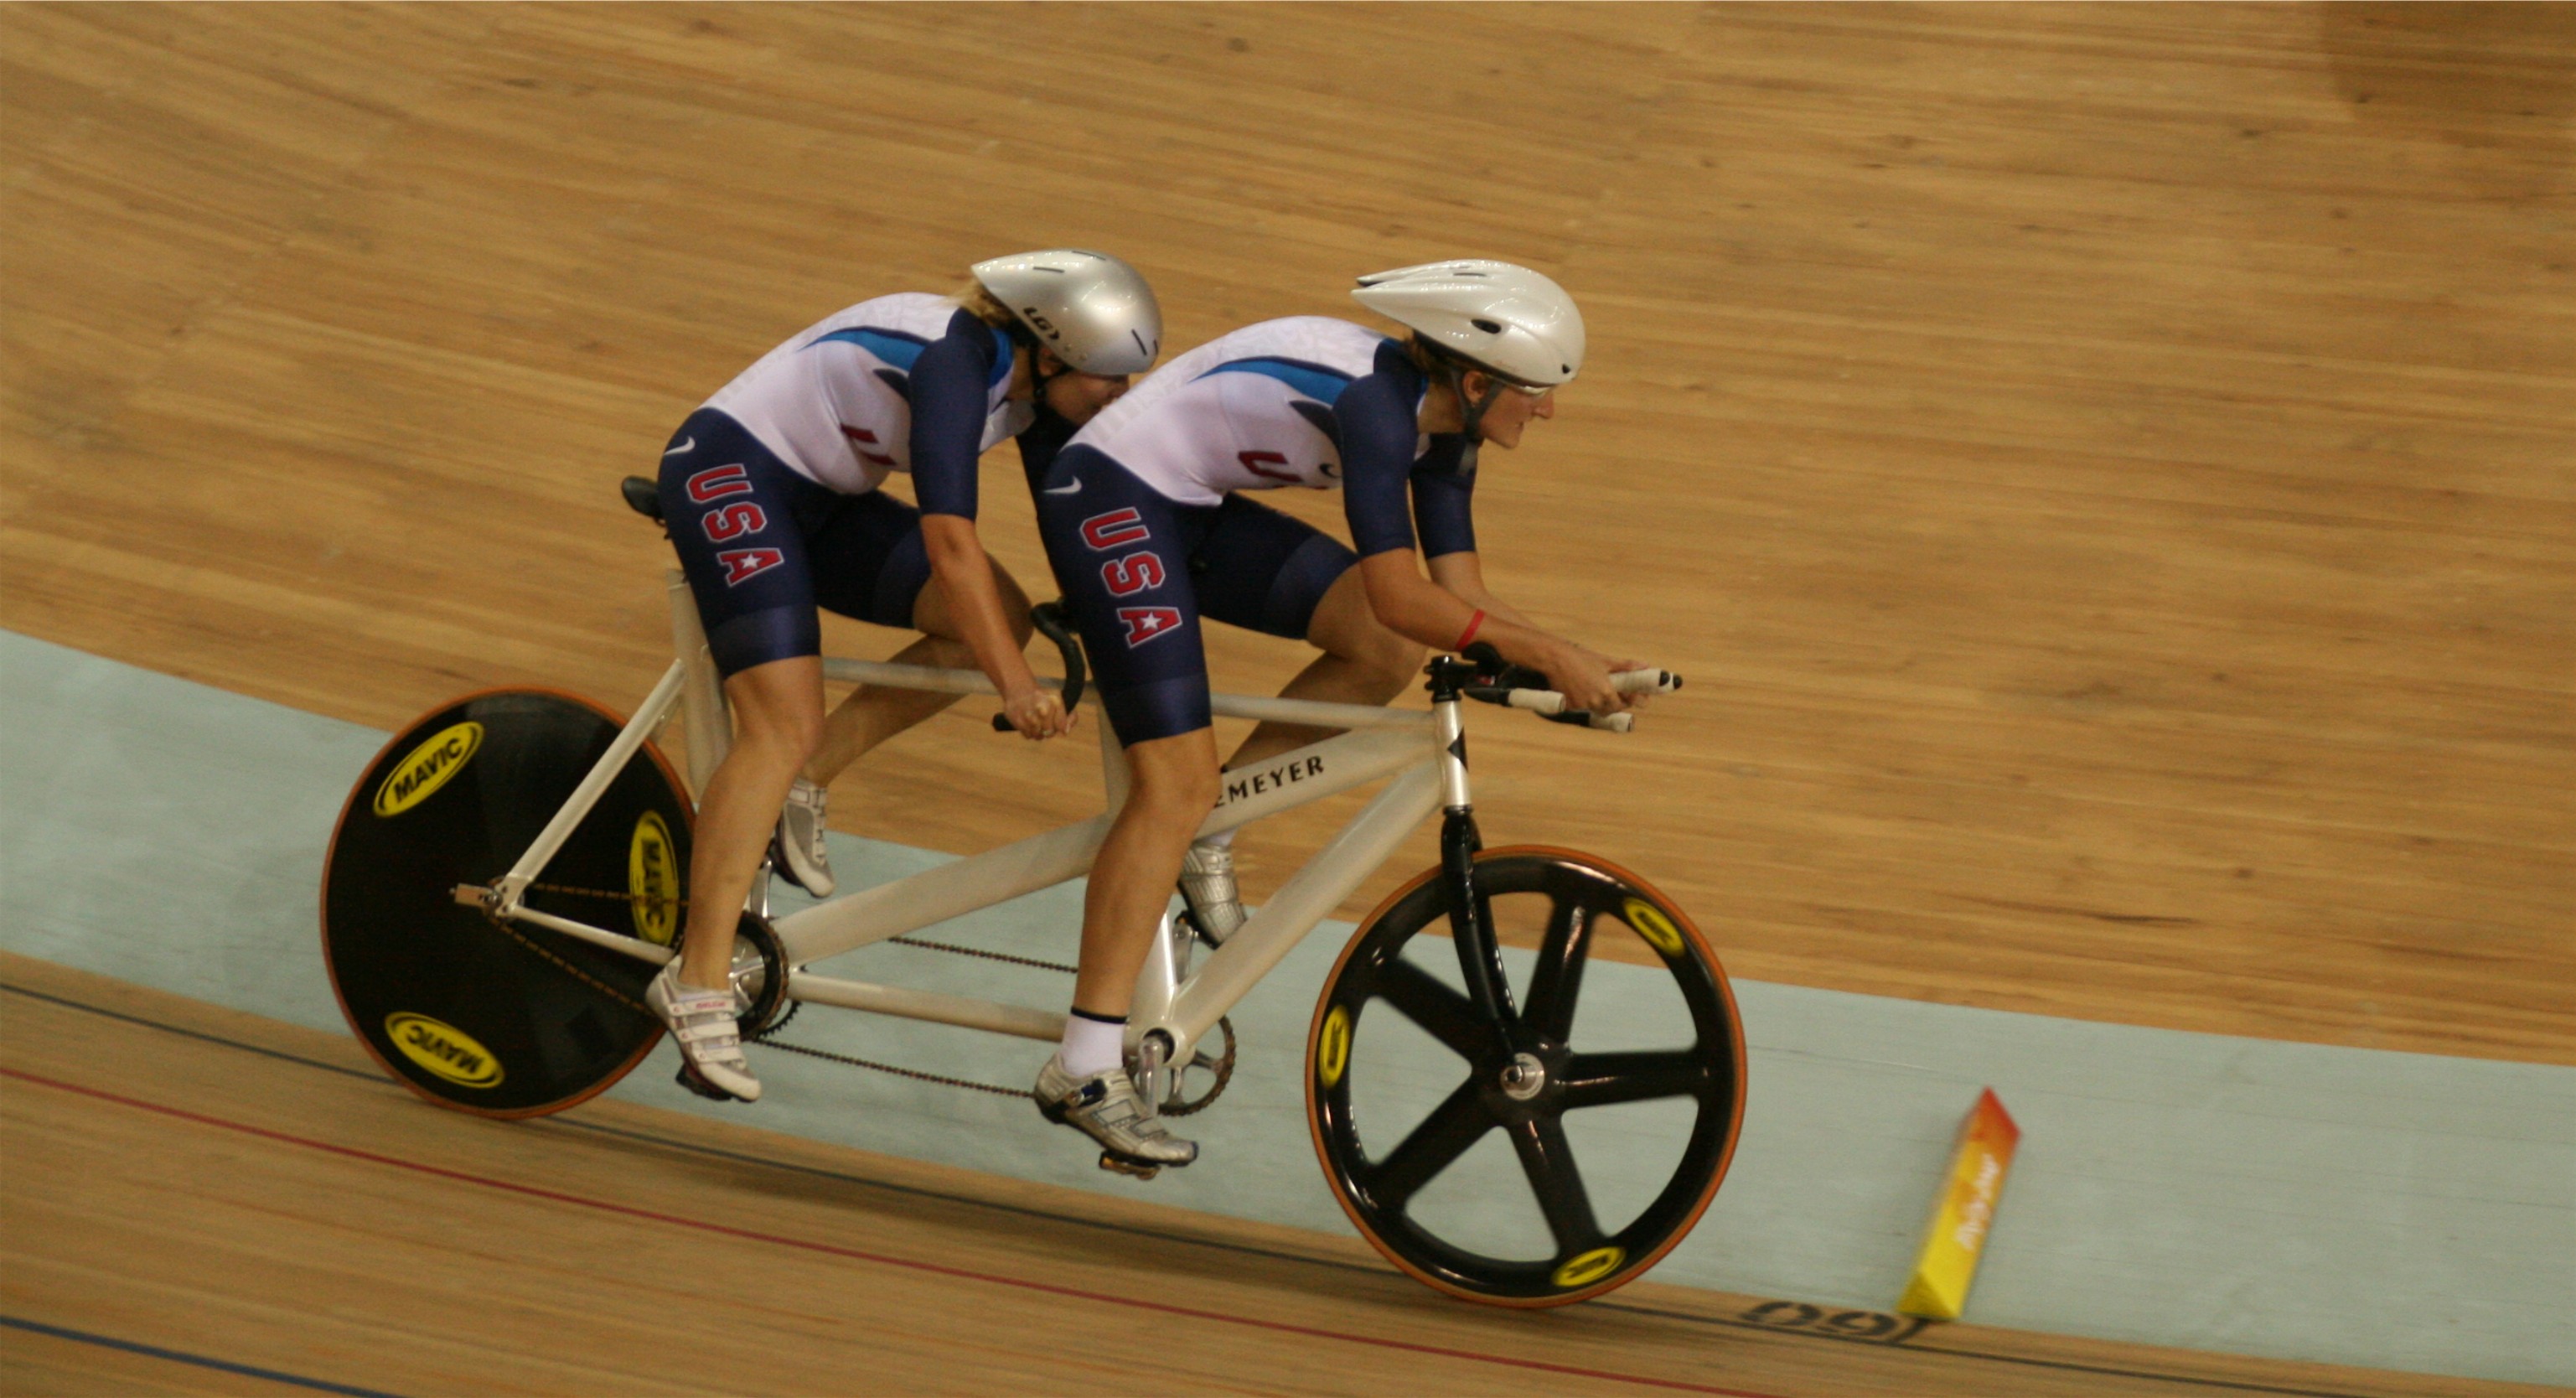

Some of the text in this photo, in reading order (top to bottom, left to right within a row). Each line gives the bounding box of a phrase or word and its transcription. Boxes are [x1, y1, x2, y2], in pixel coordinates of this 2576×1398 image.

[685, 463, 784, 587] USA
[1079, 506, 1182, 649] USA
[392, 737, 463, 803] MAVIC
[406, 1023, 485, 1075] MAVIC
